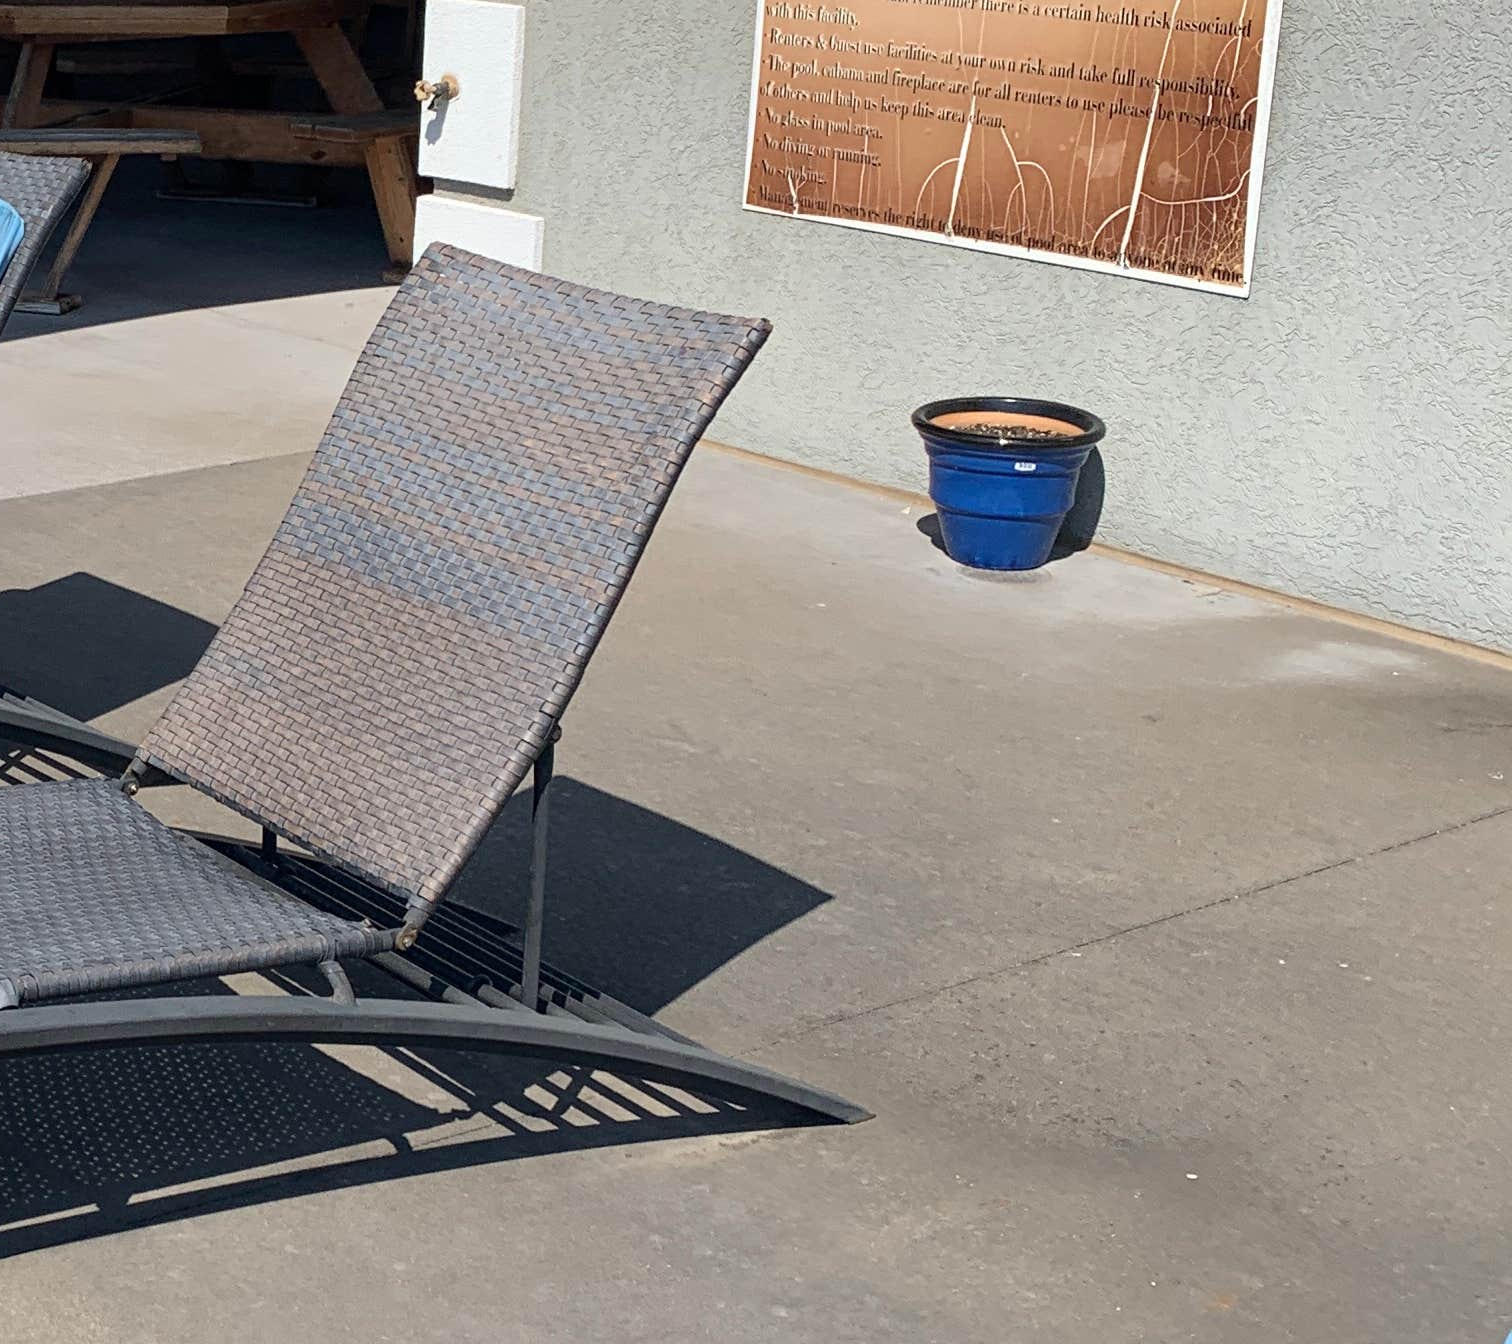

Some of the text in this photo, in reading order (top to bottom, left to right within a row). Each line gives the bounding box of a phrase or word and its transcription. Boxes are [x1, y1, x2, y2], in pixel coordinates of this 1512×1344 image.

[765, 0, 859, 31] with this facility.
[1031, 4, 1041, 17] a
[1043, 2, 1092, 22] certain
[1095, 4, 1140, 27] health
[1142, 9, 1172, 30] risk
[1174, 15, 1253, 38] associated
[769, 26, 812, 48] Renters
[814, 32, 824, 50] &
[862, 43, 883, 57] use
[886, 40, 938, 63] facilities
[940, 51, 953, 65] at
[955, 54, 987, 71] your
[989, 58, 1016, 72] own
[1019, 56, 1046, 76] risk
[1048, 60, 1075, 79] and
[1078, 63, 1108, 83] take
[1111, 66, 1136, 86] full
[809, 87, 832, 105] and
[834, 89, 861, 114] help
[864, 98, 877, 112] us
[879, 95, 910, 121] keep
[911, 100, 935, 119] this
[936, 109, 965, 123] area
[865, 68, 889, 85] and
[890, 69, 946, 94] fireplace
[948, 82, 969, 95] are
[972, 79, 992, 99] for
[993, 82, 1011, 101] all
[1014, 89, 1062, 107] renters
[1065, 94, 1079, 110] to
[1082, 98, 1106, 113] use
[1108, 96, 1153, 120] please
[1156, 101, 1175, 122] be
[763, 106, 778, 124] No
[811, 113, 822, 131] in
[825, 117, 850, 137] pool
